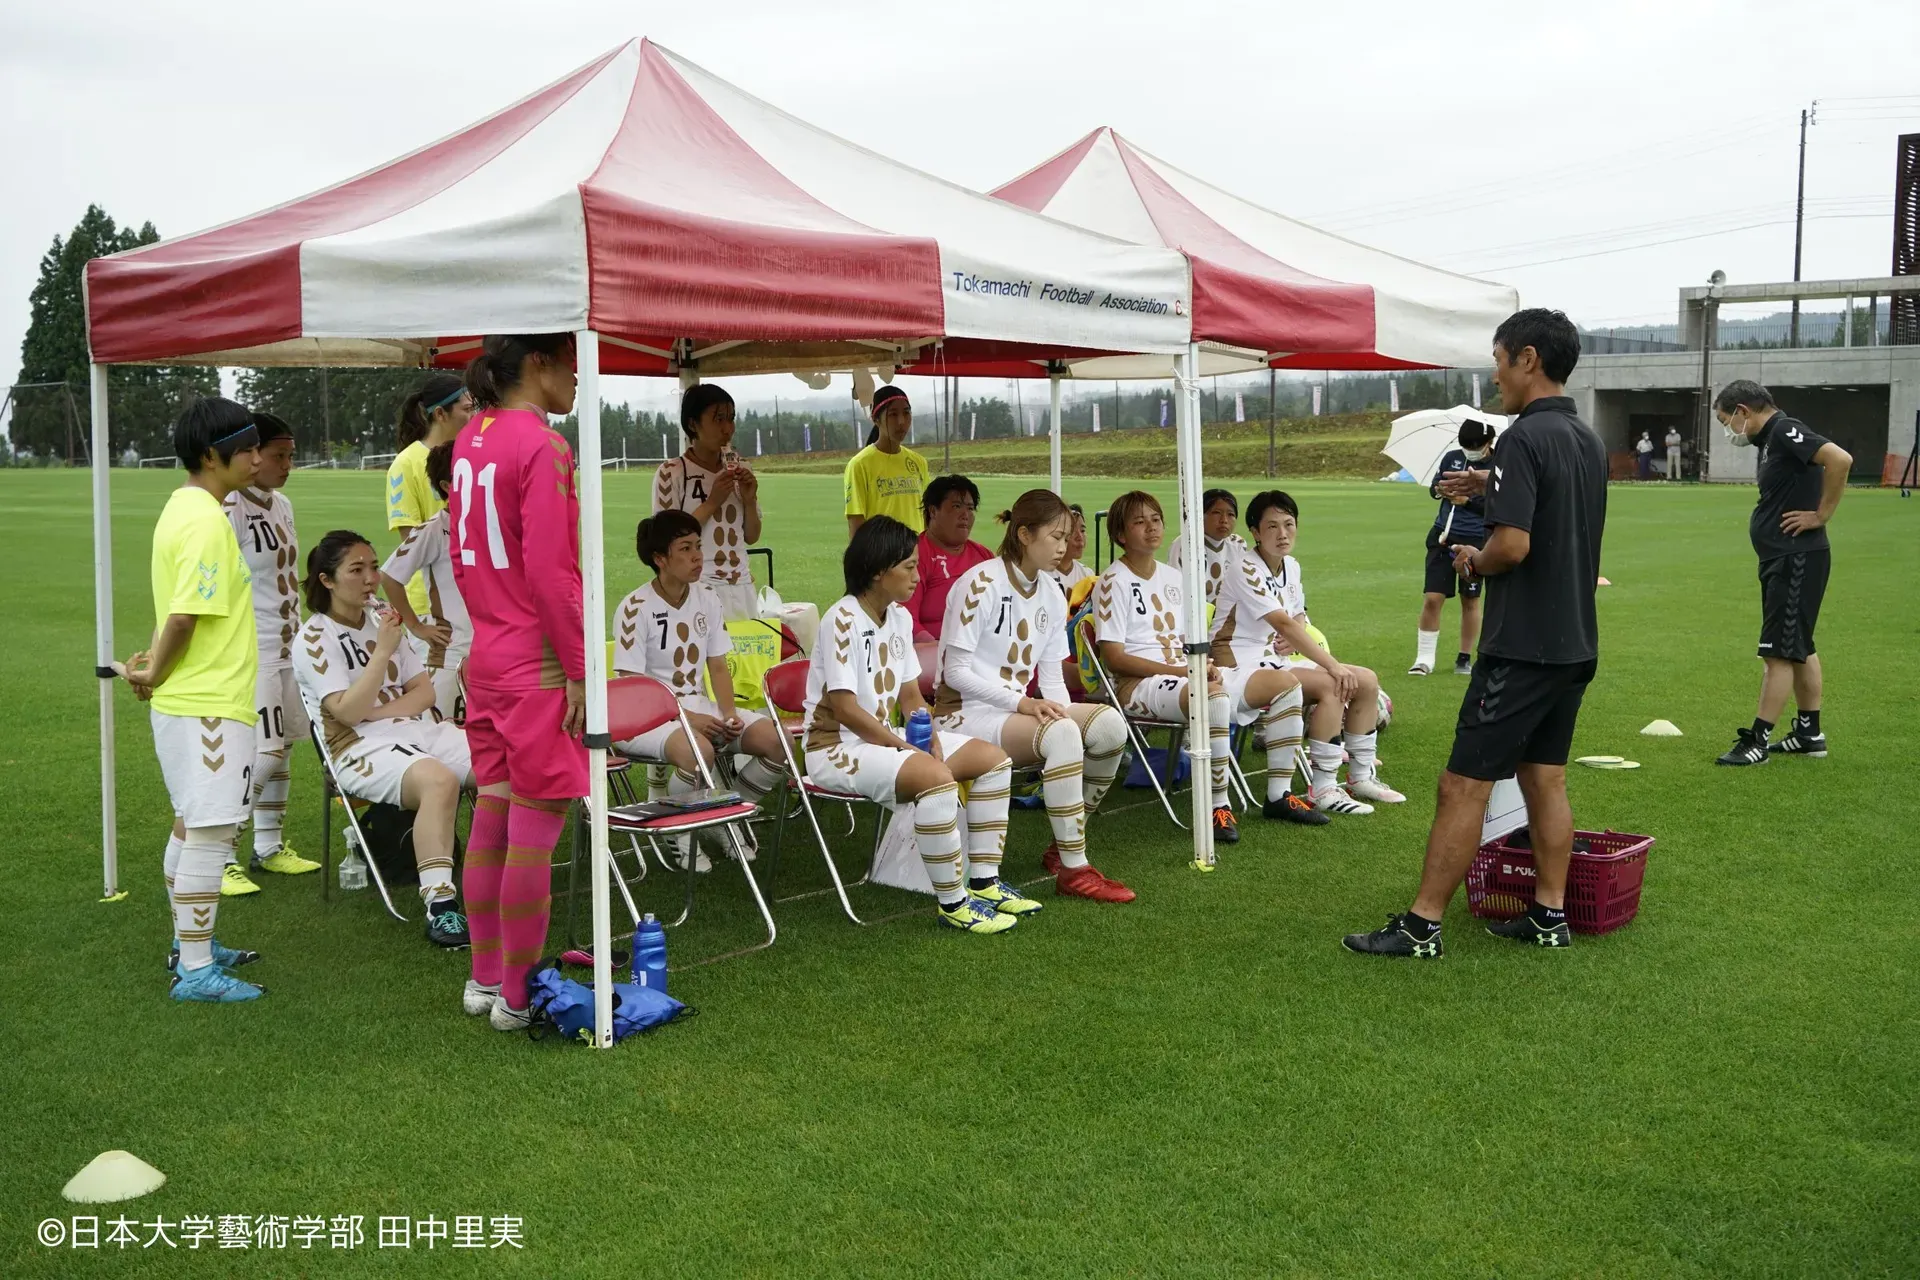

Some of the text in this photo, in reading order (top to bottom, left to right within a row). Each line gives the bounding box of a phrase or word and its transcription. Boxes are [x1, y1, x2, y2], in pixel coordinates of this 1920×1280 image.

[952, 271, 1032, 299] Tokamachi
[1040, 283, 1095, 306] Football
[1099, 292, 1168, 316] Association
[691, 479, 708, 504] 4
[453, 457, 510, 570] 21
[248, 520, 279, 553] 10
[1132, 587, 1147, 616] 3
[656, 618, 668, 650] 7
[339, 638, 371, 670] 16
[864, 637, 872, 674] 2
[1158, 678, 1179, 691] 3
[257, 705, 284, 739] 10
